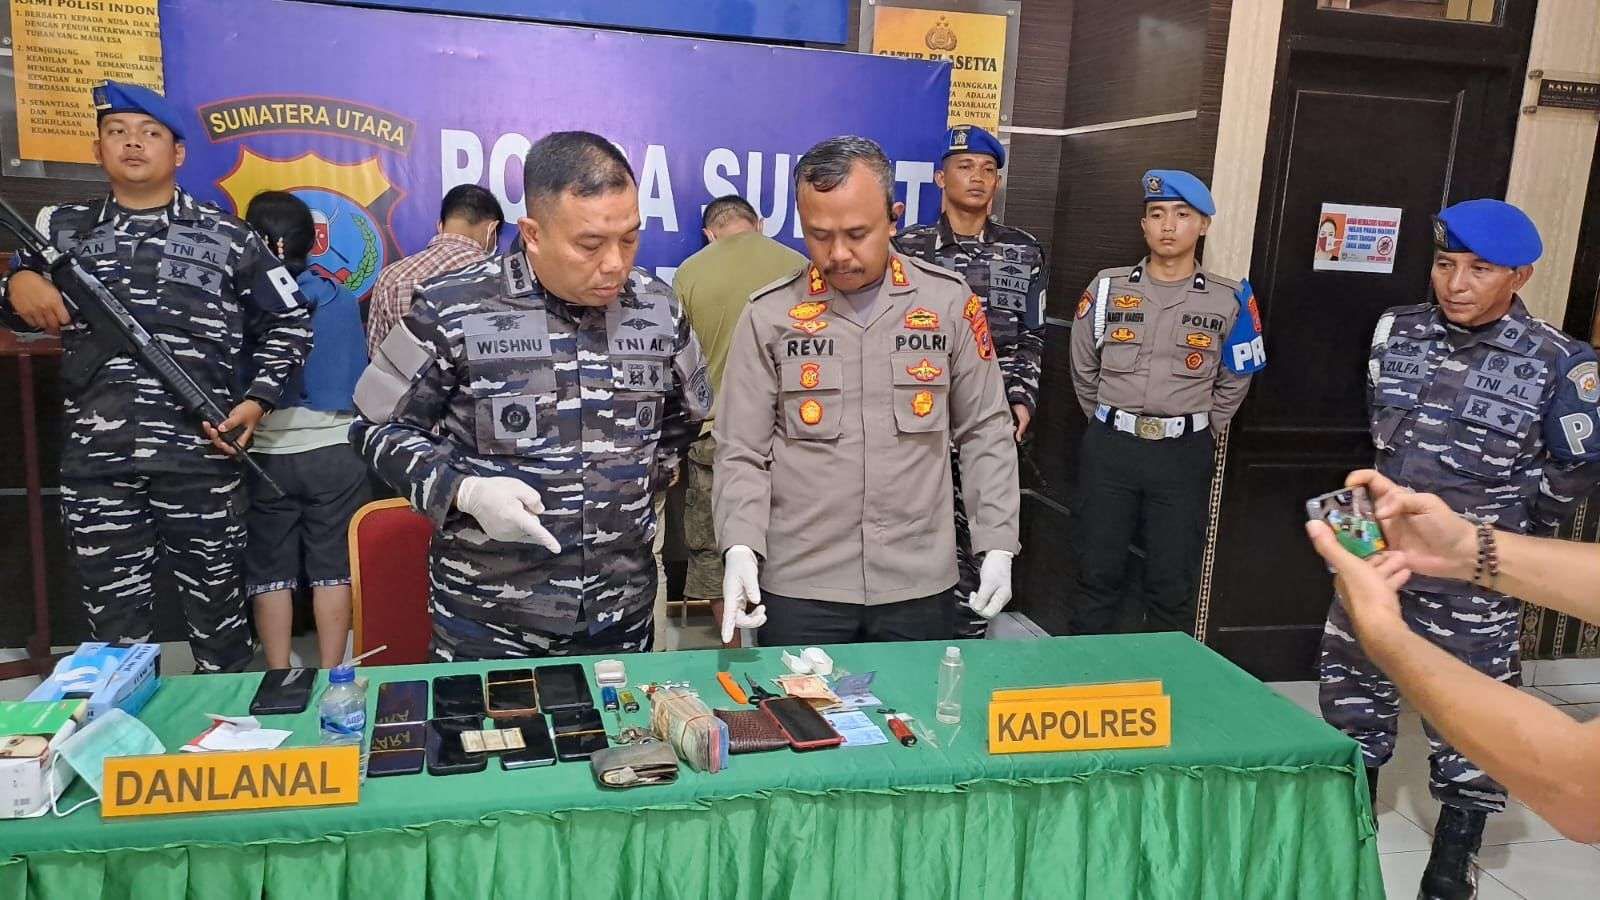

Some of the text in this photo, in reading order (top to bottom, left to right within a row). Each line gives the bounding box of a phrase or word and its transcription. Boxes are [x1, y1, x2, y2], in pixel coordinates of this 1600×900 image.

[109, 3, 155, 15] INDON
[25, 19, 58, 28] DENGAN
[71, 14, 103, 23] KEPADA
[108, 18, 129, 26] NUSA
[133, 20, 150, 28] DAN
[26, 30, 122, 44] TUHAN YANG MAHA ESA
[26, 45, 79, 55] MENJUNJUNG
[27, 55, 155, 71] KEADILAN DAN KEMANUSIAAN
[104, 71, 134, 79] HUKUM
[29, 83, 87, 94] BERDASARKAN
[966, 91, 997, 100] ADALAH
[30, 100, 80, 109] SENANTIASA
[30, 108, 95, 119] DAN MELAYANI
[964, 111, 991, 119] UNTUK
[32, 127, 77, 136] KEAMANAN
[209, 104, 405, 146] SUMATERA UTARA
[440, 129, 935, 239] POA SUT
[74, 243, 220, 264] AN TNI AL
[266, 266, 299, 308] P
[994, 278, 1025, 290] TNI AL
[1181, 313, 1223, 331] POLRI
[477, 338, 665, 356] WISHNU TNI AL
[787, 339, 834, 357] REVI
[895, 334, 946, 351] POLRI
[1476, 375, 1529, 400] TNI AL
[997, 707, 1158, 742] KAPOLRES
[115, 760, 341, 806] DANLANAL
